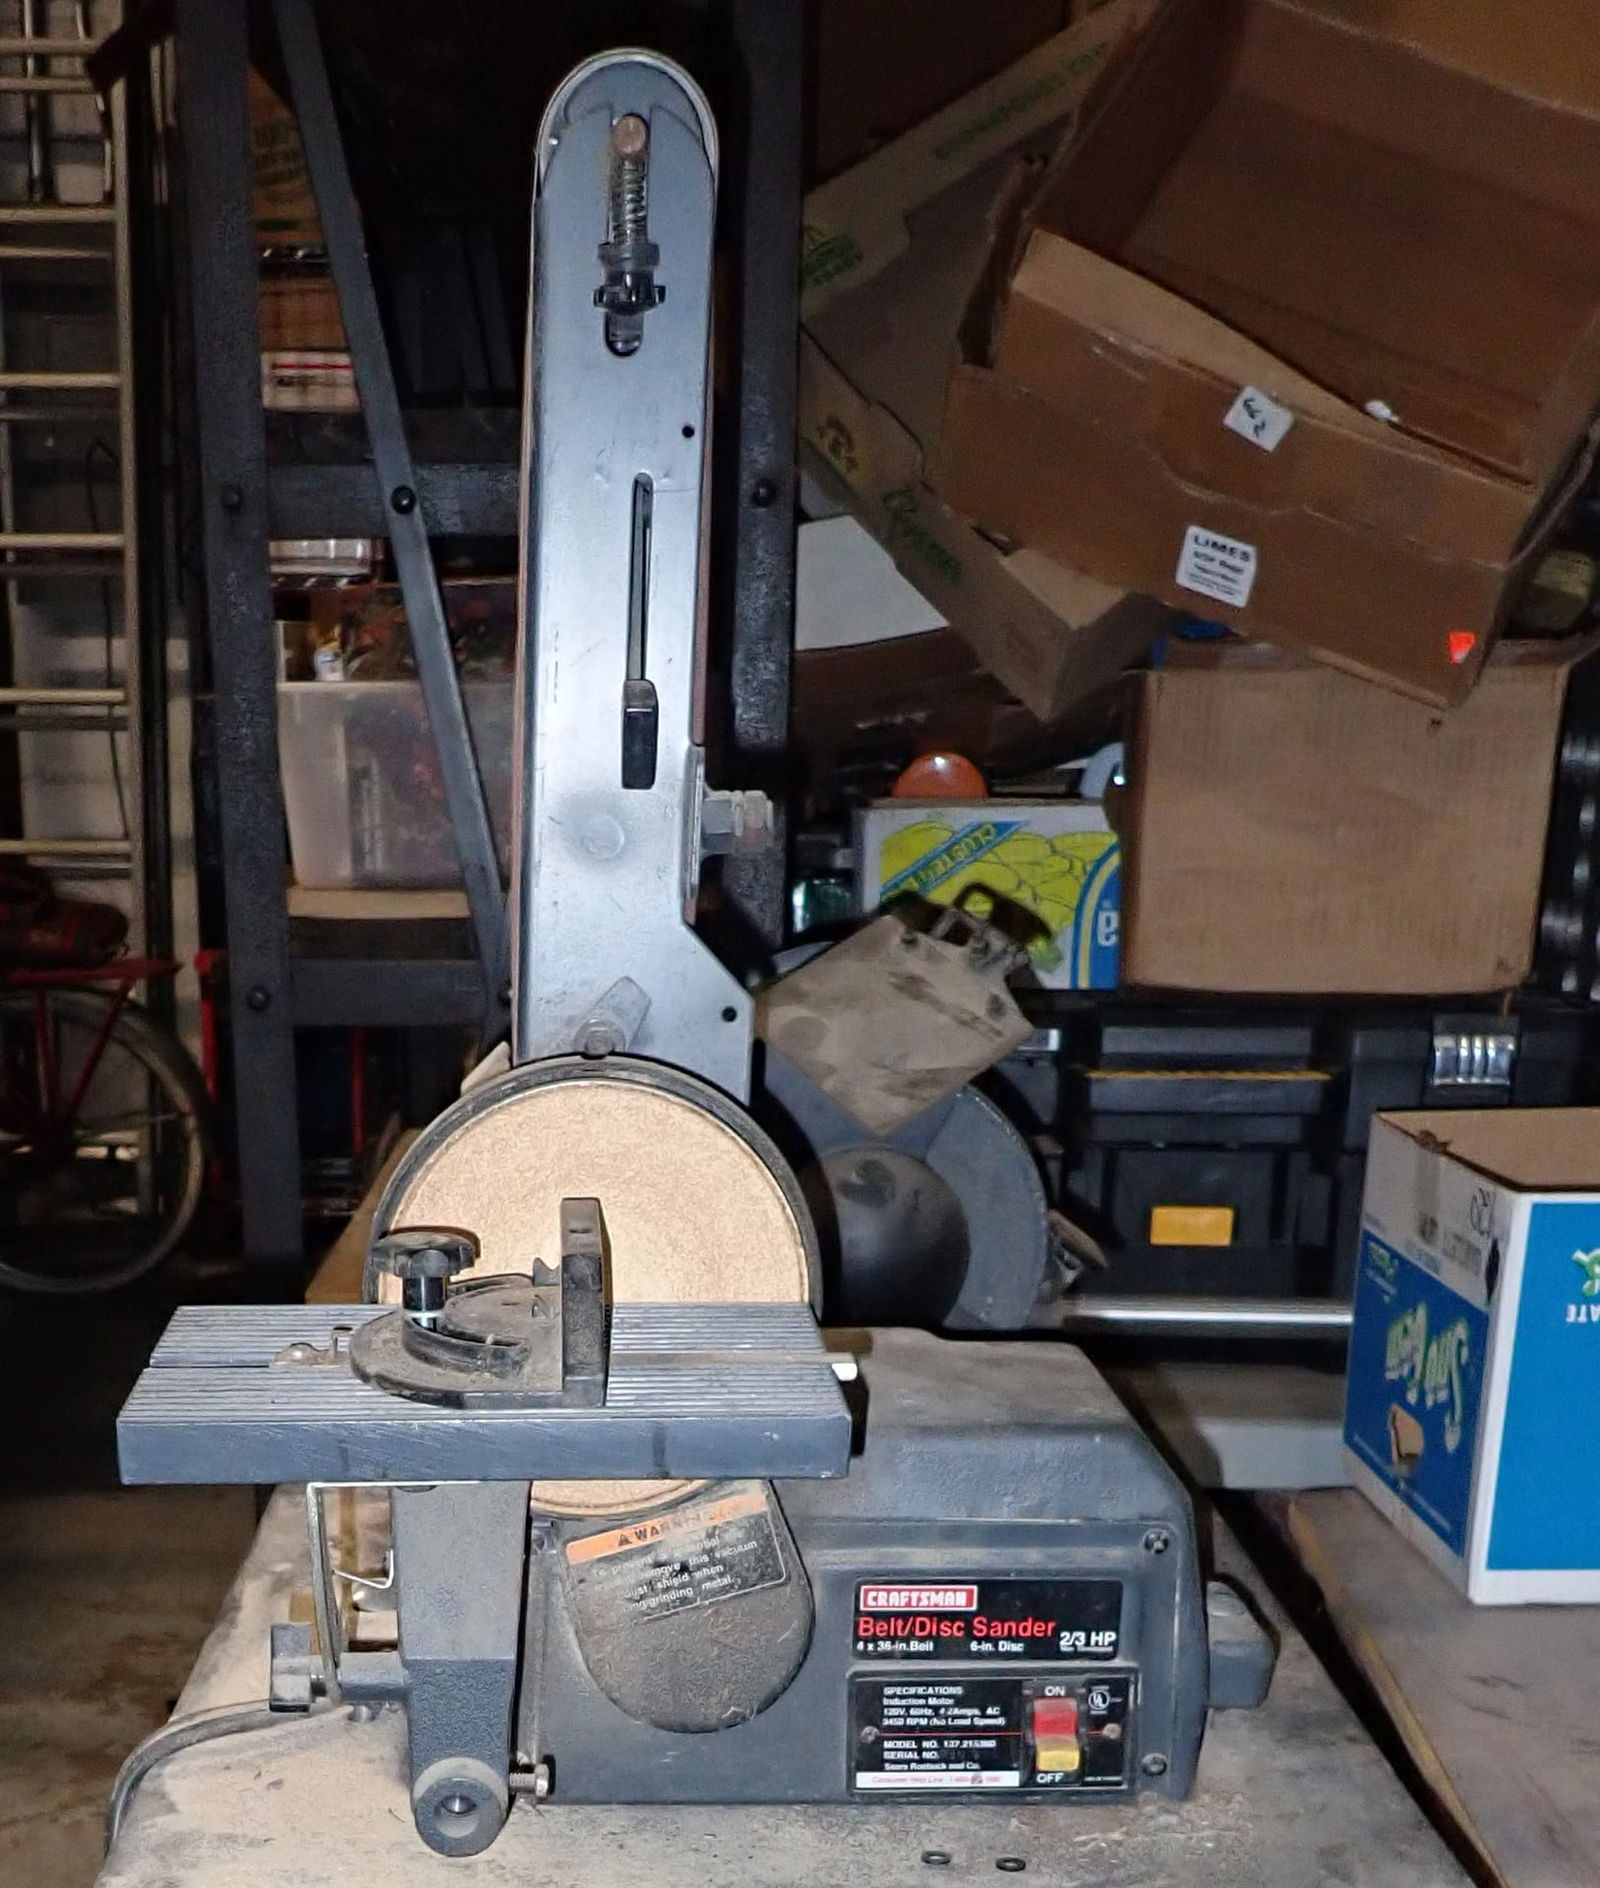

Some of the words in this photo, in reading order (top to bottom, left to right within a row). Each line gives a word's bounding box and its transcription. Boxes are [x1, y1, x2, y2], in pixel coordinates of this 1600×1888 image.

[1194, 535, 1250, 562] LIMES
[867, 1590, 968, 1607] CRAFTSMAN
[858, 1616, 965, 1638] Belt/Disc
[972, 1616, 1057, 1638] Sander
[1059, 1631, 1086, 1648] 2/3
[1090, 1631, 1117, 1646] HP
[857, 1641, 864, 1651] 4
[866, 1643, 874, 1651] x
[970, 1641, 996, 1652] 6-in.
[998, 1641, 1025, 1652] Disc
[883, 1686, 963, 1695] SPECIFICATIONS
[1044, 1686, 1066, 1697] ON
[883, 1697, 926, 1705] Induction
[928, 1697, 954, 1705] Motor
[986, 1706, 1001, 1715] AC
[906, 1717, 928, 1726] RPM
[883, 1740, 918, 1749] MODEL
[922, 1740, 939, 1749] NO.
[883, 1751, 920, 1760] SERIAL
[922, 1750, 940, 1760] NO.
[1036, 1772, 1065, 1783] OFF
